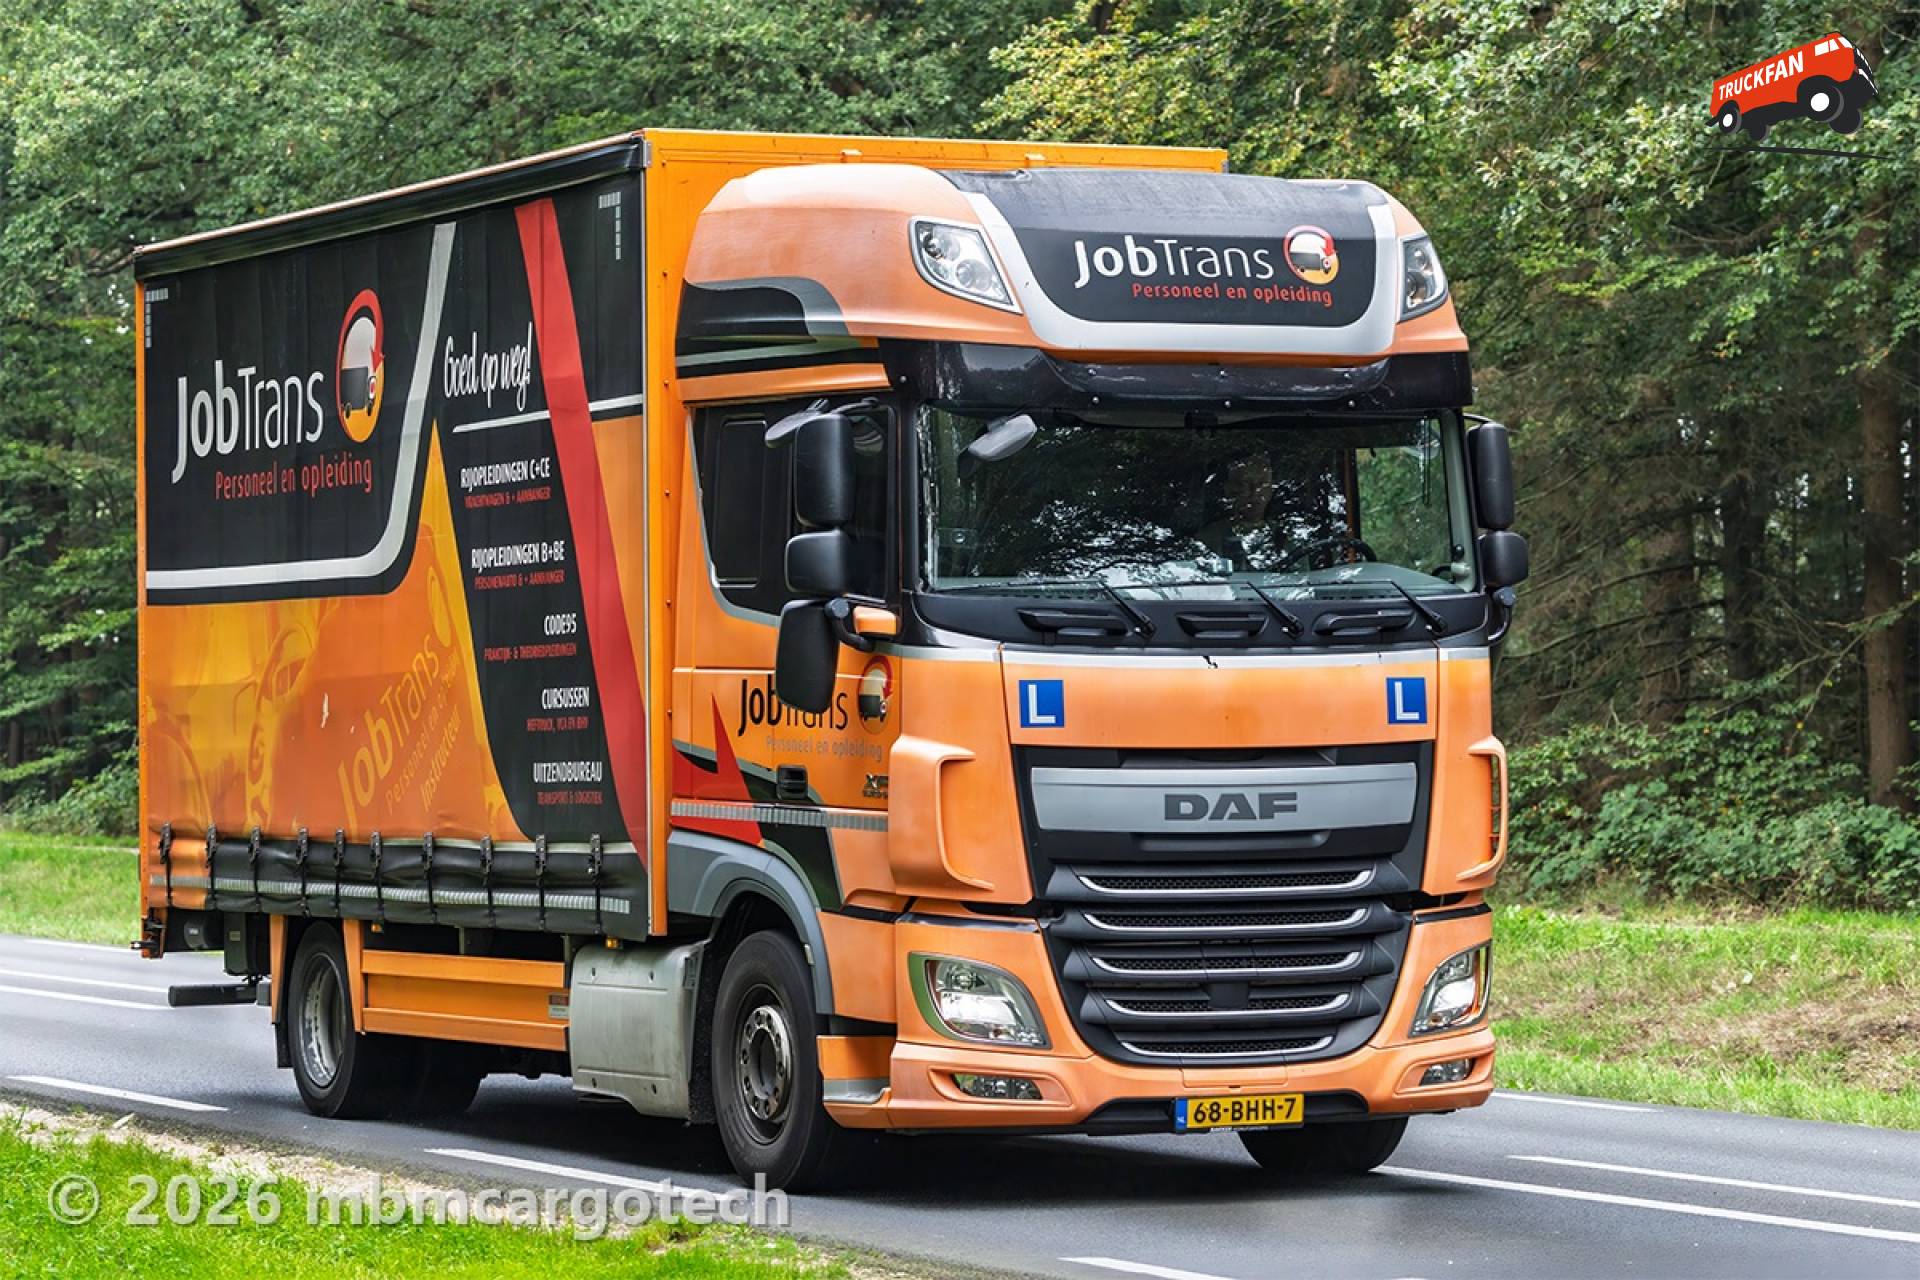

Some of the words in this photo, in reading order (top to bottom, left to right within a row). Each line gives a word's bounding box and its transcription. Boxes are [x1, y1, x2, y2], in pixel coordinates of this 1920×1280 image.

[1074, 234, 1274, 289] JobTrans
[1131, 282, 1220, 299] Personeel
[1226, 286, 1247, 299] en
[1253, 283, 1333, 308] opleiding
[444, 331, 480, 398] Goed
[481, 352, 498, 408] op
[501, 321, 533, 411] weg!
[171, 359, 325, 485] JobTrans
[215, 461, 278, 500] Personeel
[281, 466, 296, 491] en
[302, 452, 373, 498] opleiding
[460, 461, 529, 493] RIJOPLEIDINGEN
[529, 457, 551, 479] C+CE
[471, 542, 540, 573] RIJOPLEIDINGEN
[541, 540, 566, 563] B+BE
[543, 612, 577, 636] CODE95
[541, 686, 590, 710] CURSUSSEN
[1027, 683, 1056, 724] L
[1393, 681, 1420, 721] L
[336, 634, 440, 843] JobTrans
[533, 761, 603, 783] UITZENDBUREAU
[1164, 792, 1298, 821] DAF
[1193, 1098, 1297, 1124] 68-BHH-7
